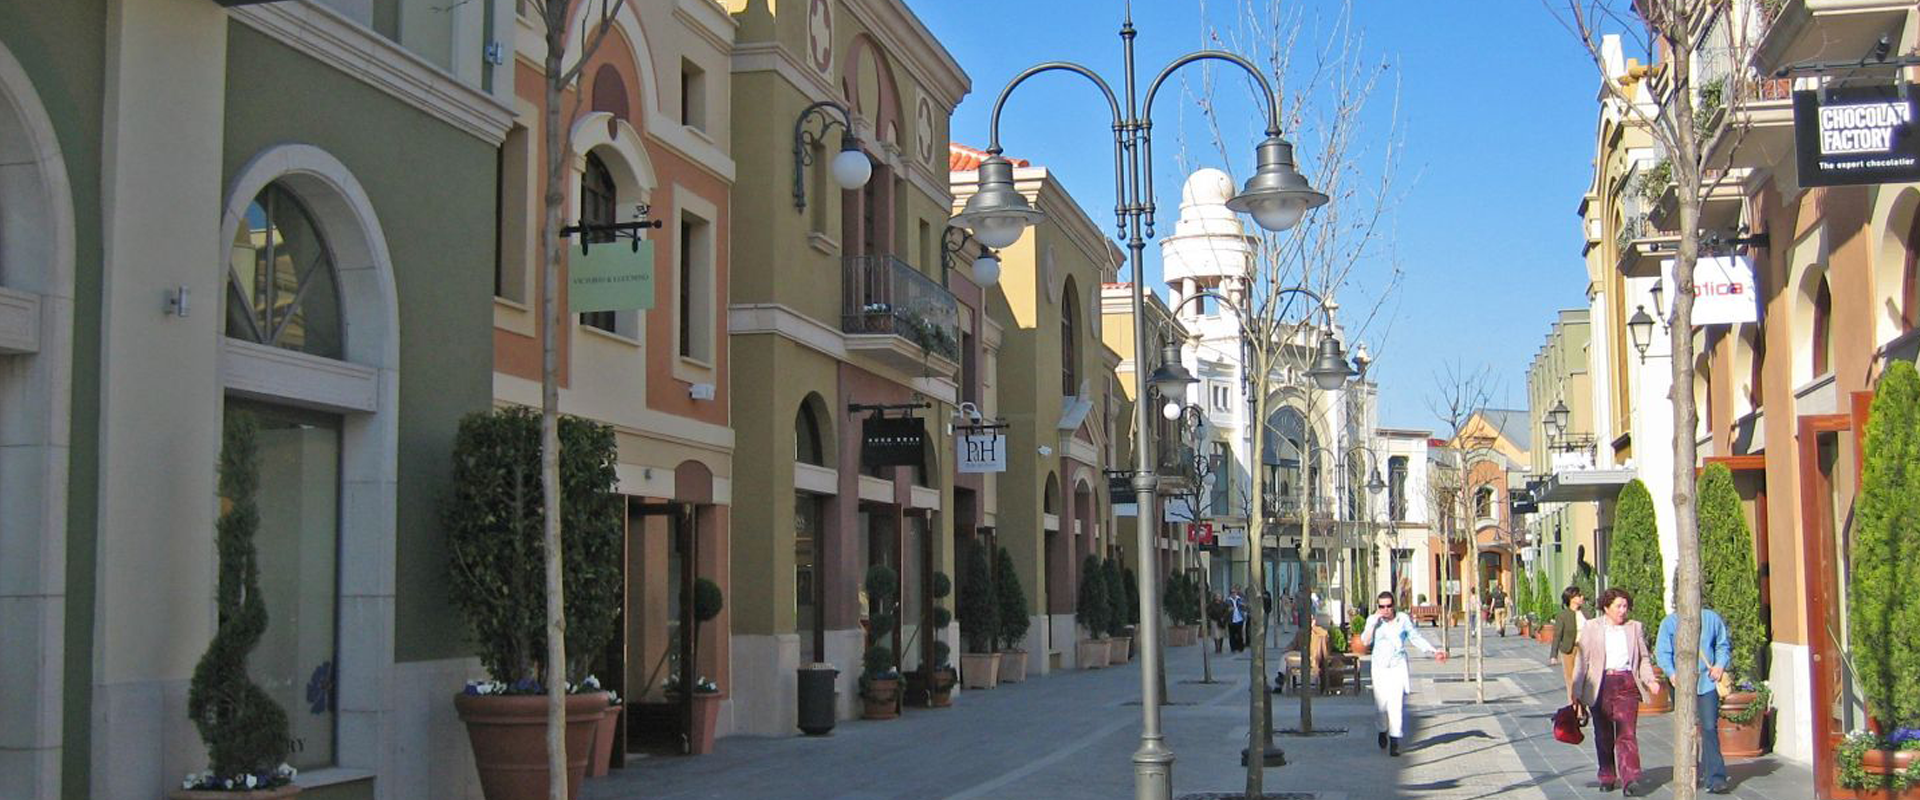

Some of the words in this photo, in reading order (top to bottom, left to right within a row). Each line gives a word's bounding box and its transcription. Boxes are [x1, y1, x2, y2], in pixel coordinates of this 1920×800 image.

[1822, 105, 1906, 130] CHOCOLAT
[1823, 127, 1892, 151] FACTORY
[1819, 162, 1835, 170] The
[1837, 160, 1864, 170] expert
[1866, 158, 1915, 167] chocolatier
